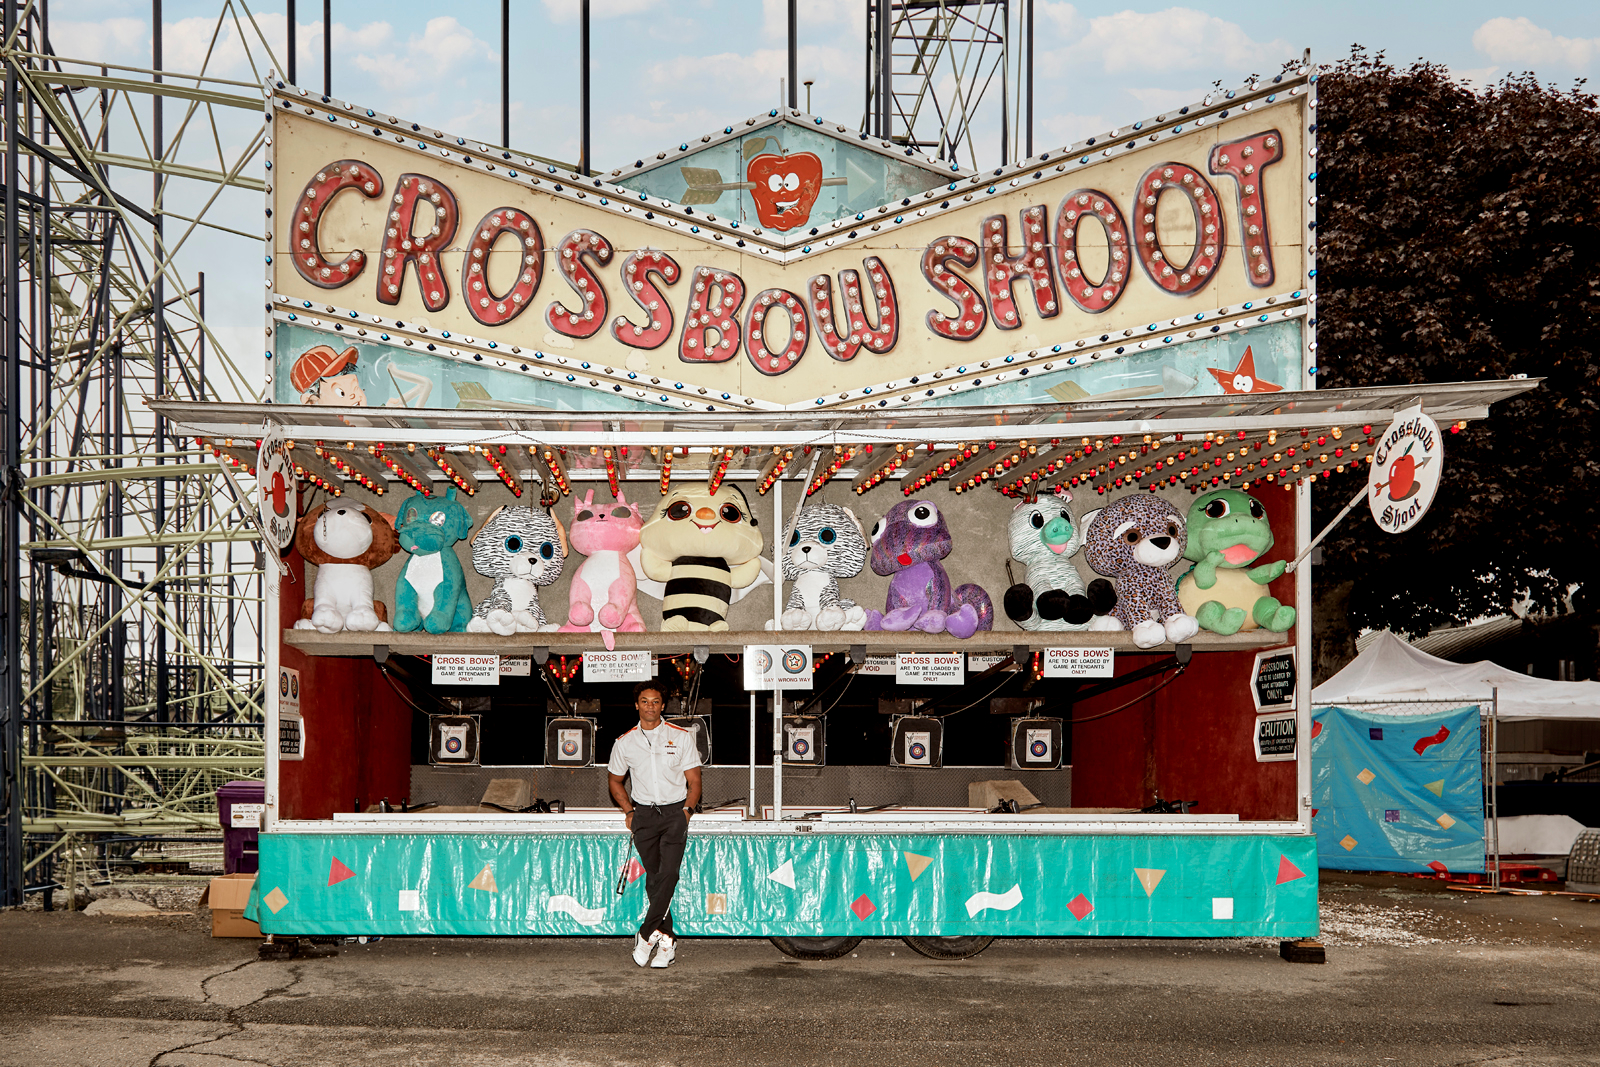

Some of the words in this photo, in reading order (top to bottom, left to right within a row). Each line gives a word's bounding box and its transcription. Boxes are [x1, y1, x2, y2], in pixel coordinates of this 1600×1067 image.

[289, 159, 899, 375] CROSSBOW
[921, 129, 1283, 342] SHOOT
[1376, 417, 1434, 467] Crossbow
[1380, 498, 1422, 532] Shoot
[1267, 689, 1282, 699] ONLY!
[1261, 720, 1294, 737] CAUTION
